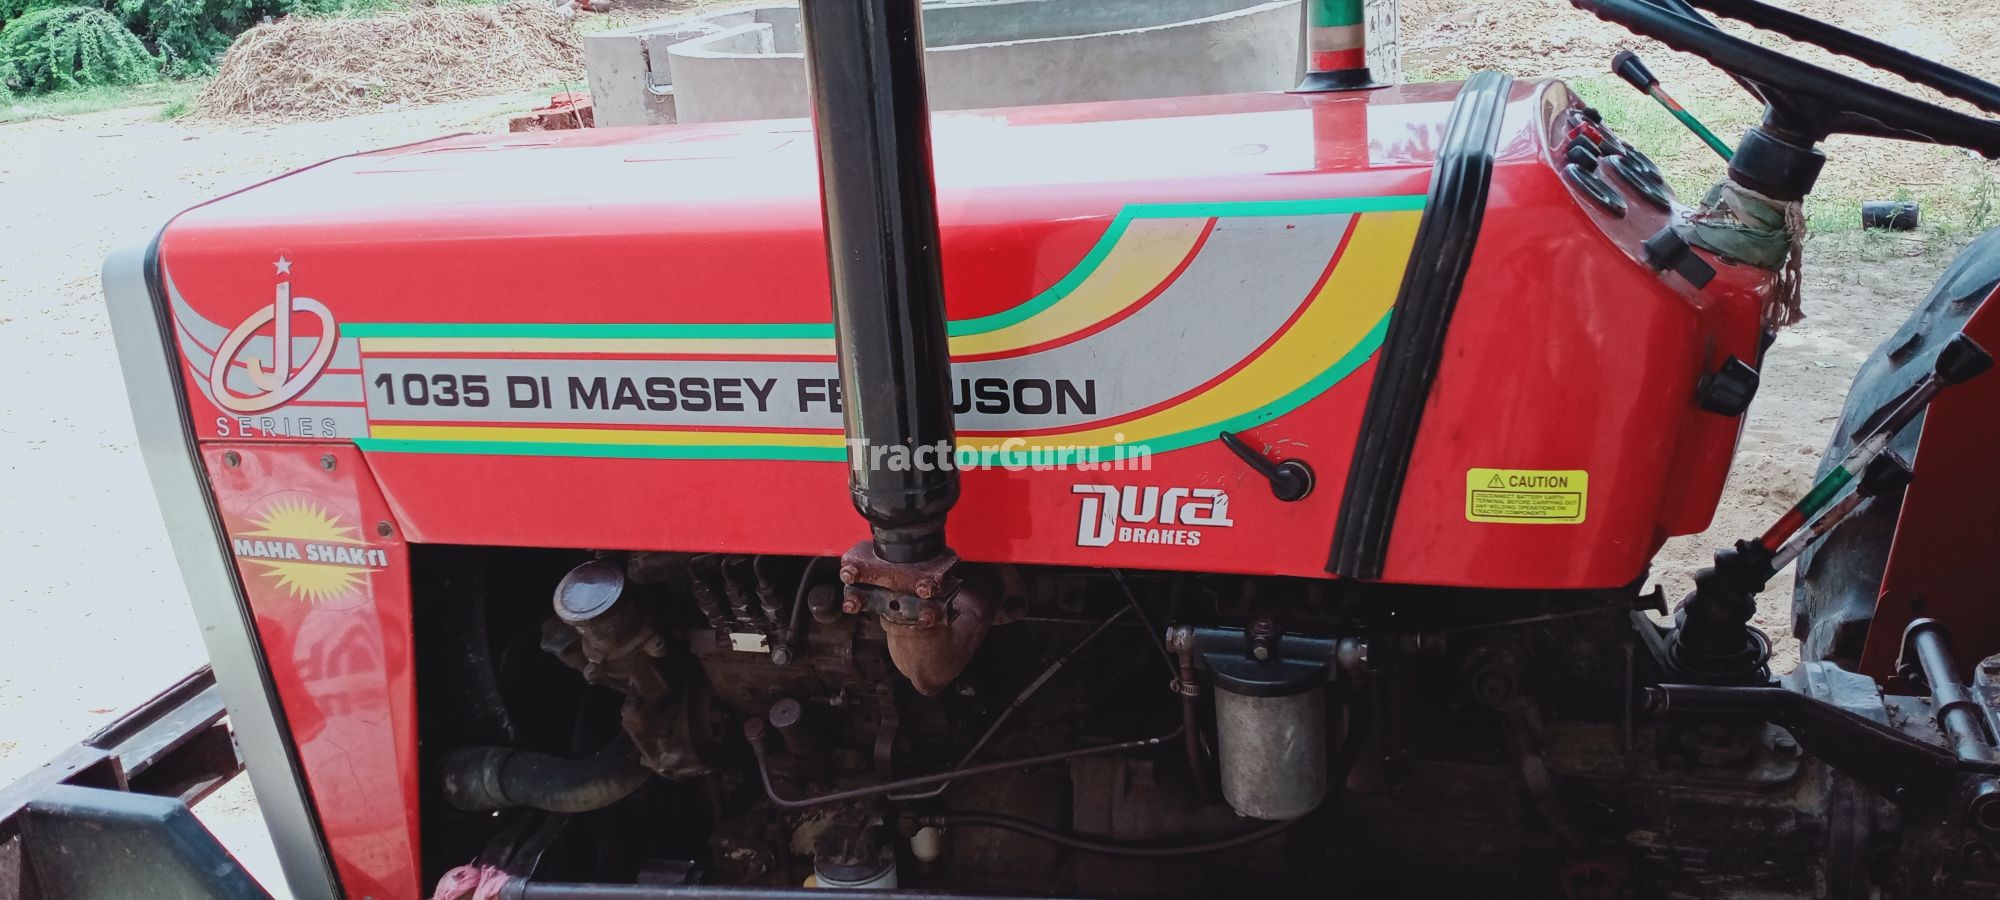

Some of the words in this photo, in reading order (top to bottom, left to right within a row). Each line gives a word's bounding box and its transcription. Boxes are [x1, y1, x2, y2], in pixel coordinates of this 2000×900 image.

[374, 373, 489, 407] 1035
[507, 375, 552, 409] DI
[567, 376, 777, 412] MASSEY
[797, 377, 1097, 414] FEUSON
[216, 416, 338, 439] SERIES
[1508, 475, 1568, 488] CAUTION
[1118, 527, 1201, 546] BRAKES
[233, 538, 302, 560] MAHA
